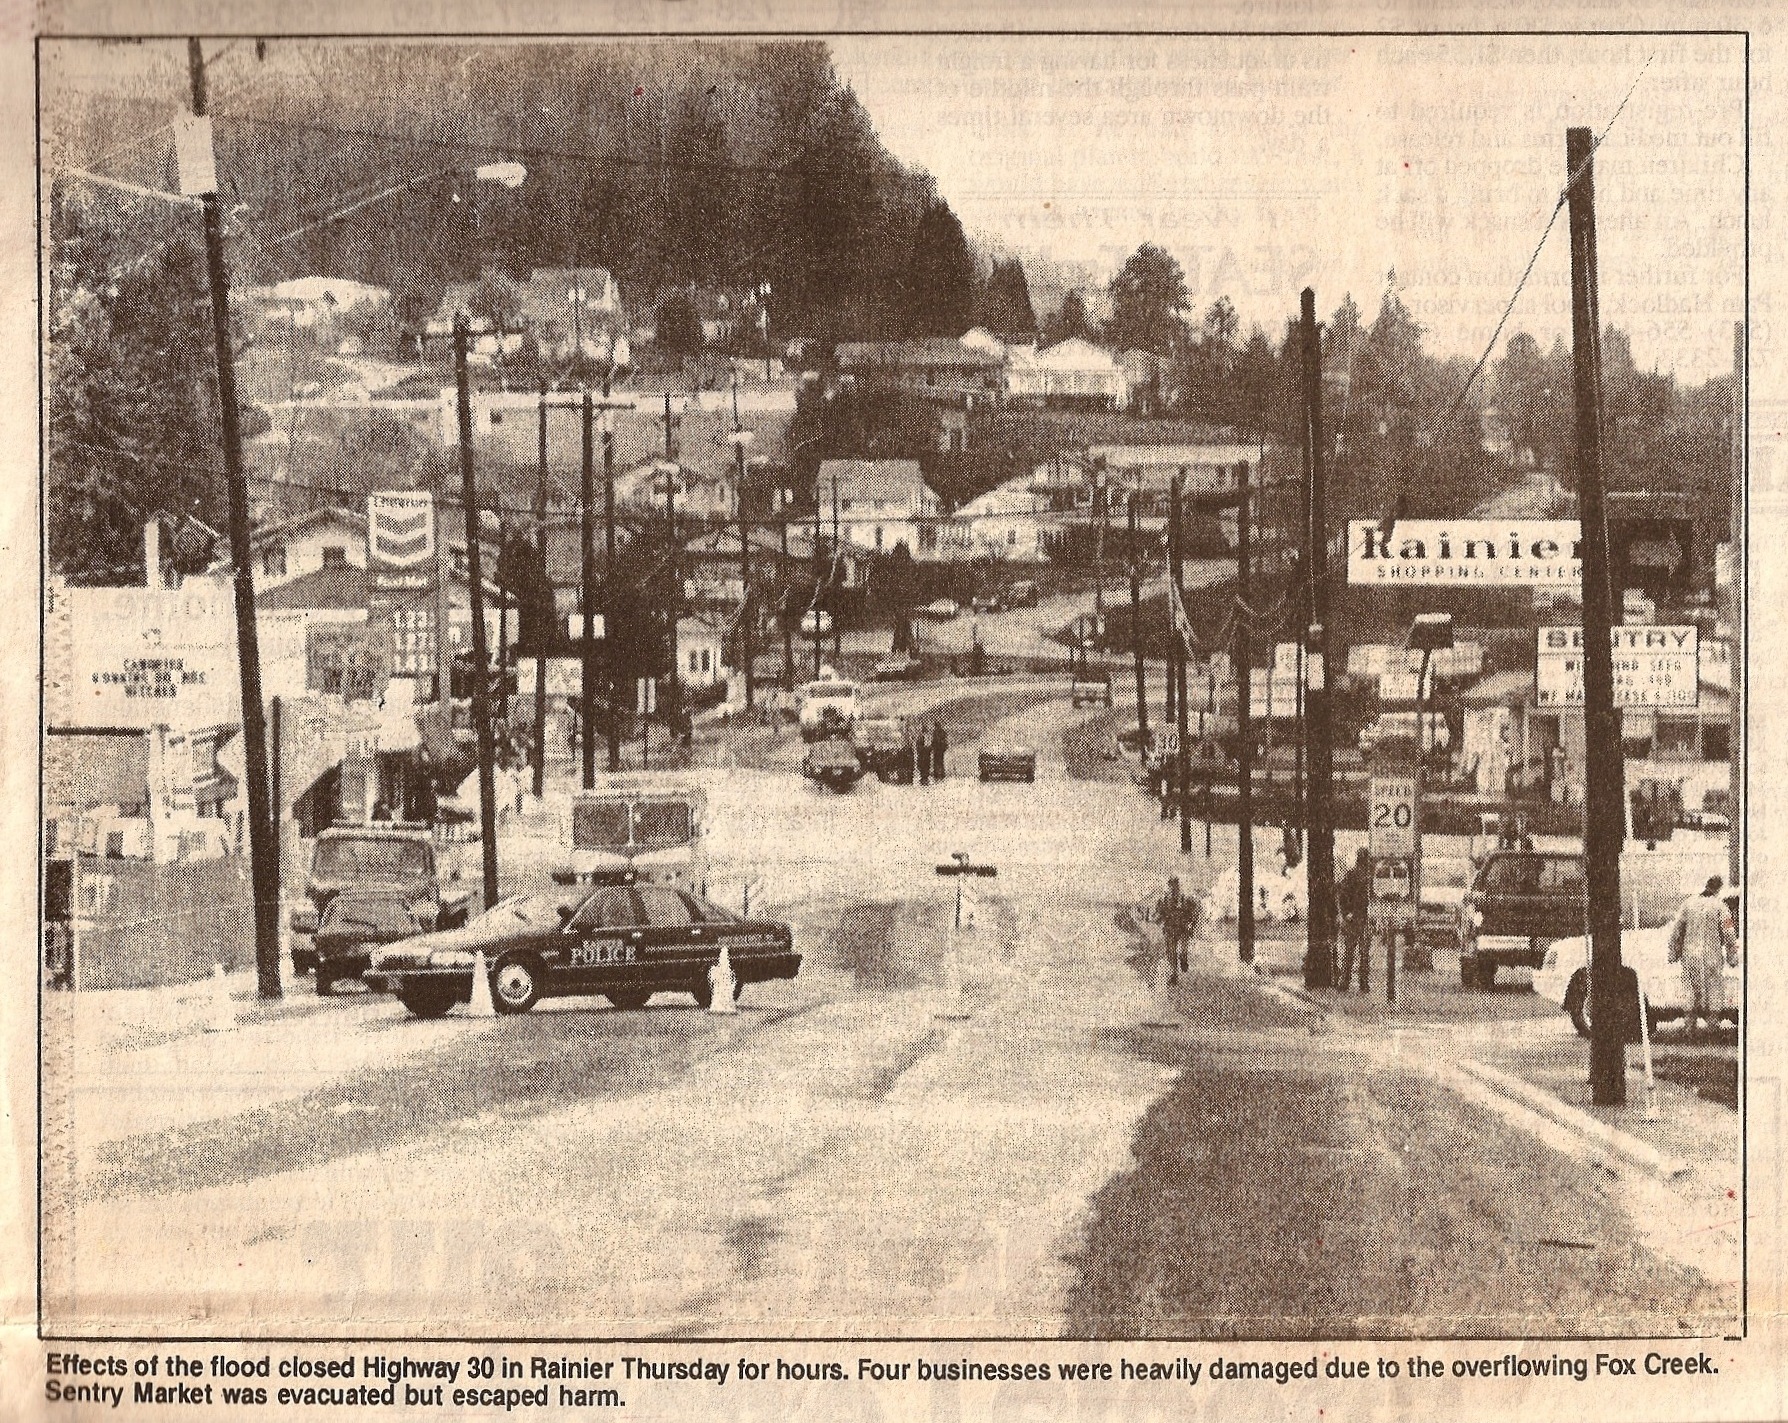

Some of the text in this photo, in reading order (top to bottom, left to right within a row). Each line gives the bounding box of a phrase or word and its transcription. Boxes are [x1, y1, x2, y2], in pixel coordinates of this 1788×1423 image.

[1361, 526, 1582, 560] Rainier
[1377, 565, 1582, 579] SHOPPING CENTER
[1547, 630, 1691, 648] SETRY
[1373, 803, 1412, 828] 20
[570, 946, 636, 964] POLICE
[46, 1352, 1719, 1386] Effects of the flood closed Highway 30 in Rainier Thursday for hours. Four businesses were heavily damaged due to the overflowing Fox Creek.
[45, 1378, 626, 1412] Sentry Market was evacuated but escaped harm.
